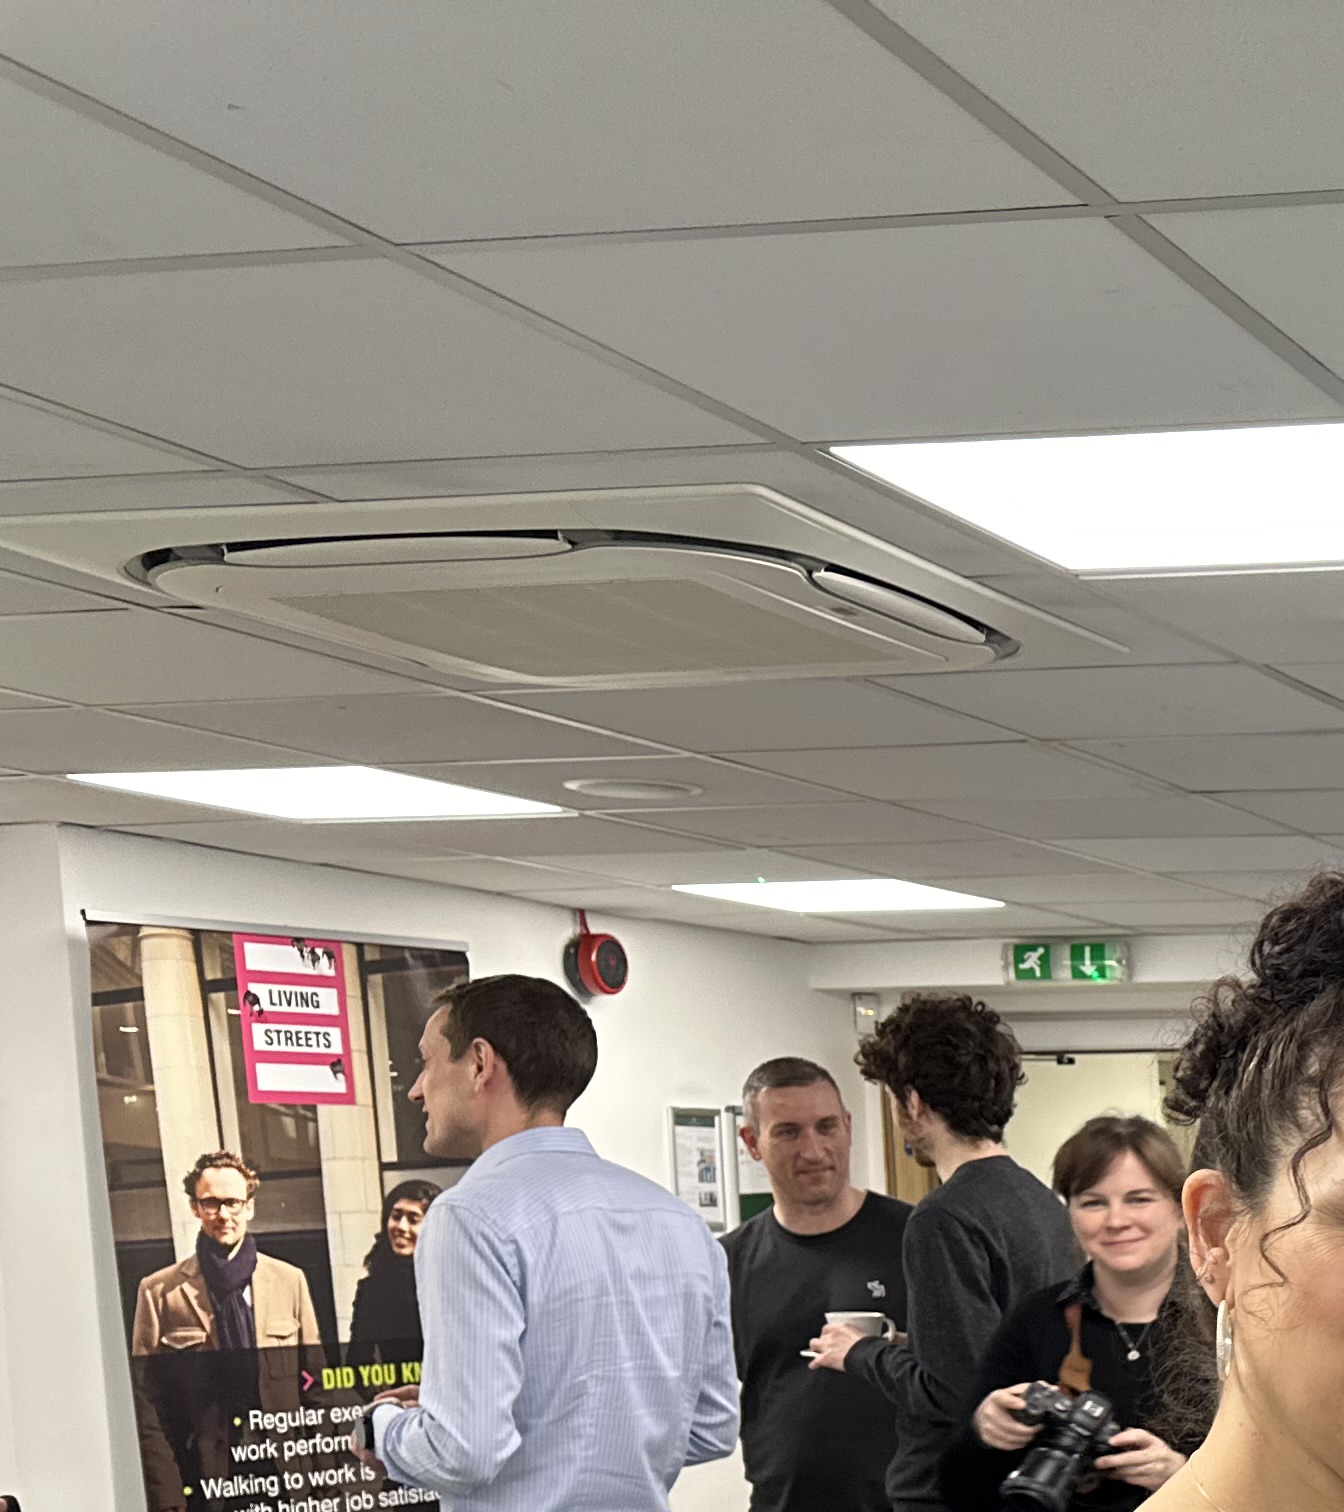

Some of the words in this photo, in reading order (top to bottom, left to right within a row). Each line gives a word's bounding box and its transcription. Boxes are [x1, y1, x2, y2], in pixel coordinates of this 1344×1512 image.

[268, 989, 320, 1009] LIVING
[264, 1029, 331, 1048] STREETS
[322, 1367, 355, 1390] DID
[359, 1365, 396, 1387] YOU
[249, 1407, 324, 1434] Regular
[231, 1438, 278, 1463] work
[201, 1472, 278, 1499] Walking
[284, 1472, 301, 1489] to
[308, 1466, 355, 1486] work
[360, 1463, 375, 1482] is
